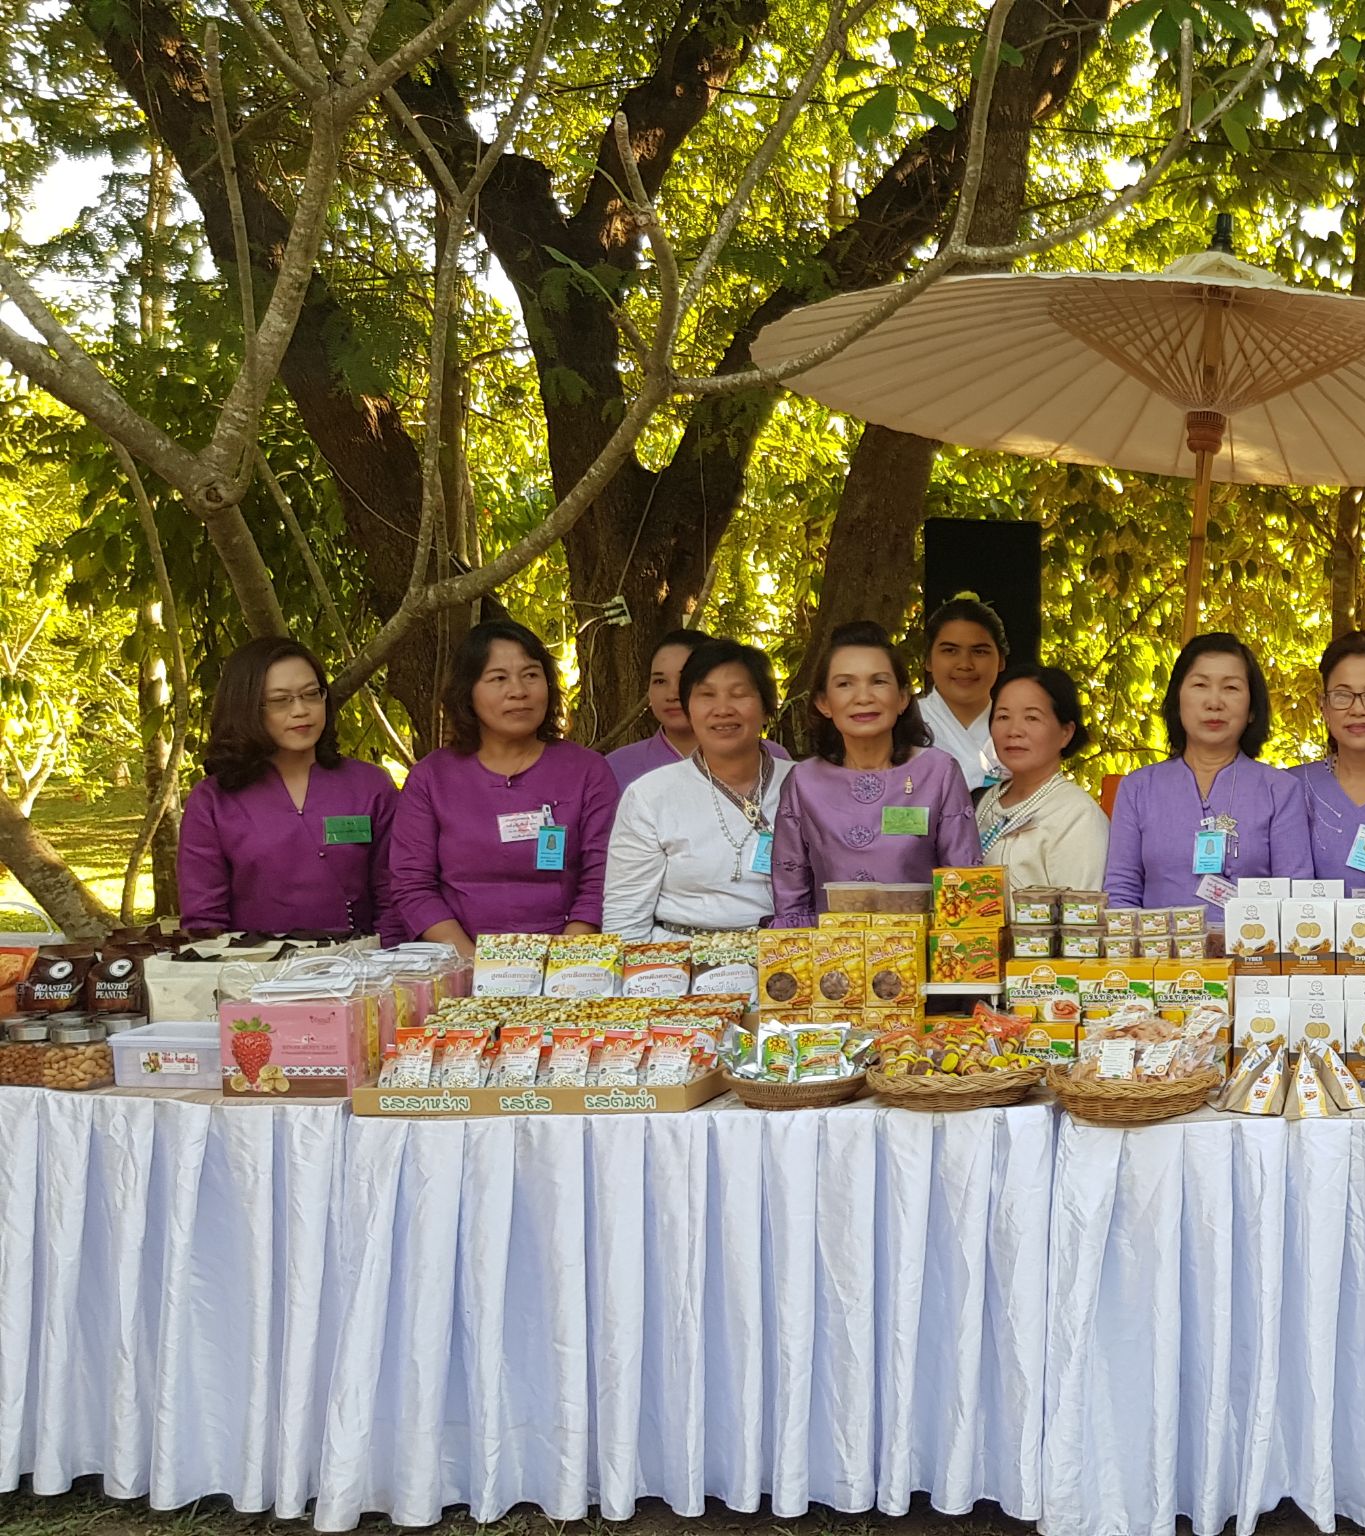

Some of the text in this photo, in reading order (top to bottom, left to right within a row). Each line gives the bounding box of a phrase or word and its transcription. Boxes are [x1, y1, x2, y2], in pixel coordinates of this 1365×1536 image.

[35, 983, 73, 992] ROASTED
[96, 982, 129, 990] ROASTED
[34, 991, 70, 1000] PEANUTS
[95, 991, 128, 1000] PEANUTS
[381, 1091, 469, 1109] รสสาหร่าย
[501, 1093, 551, 1110] รสชีส
[586, 1090, 655, 1108] รสต้มยำ
